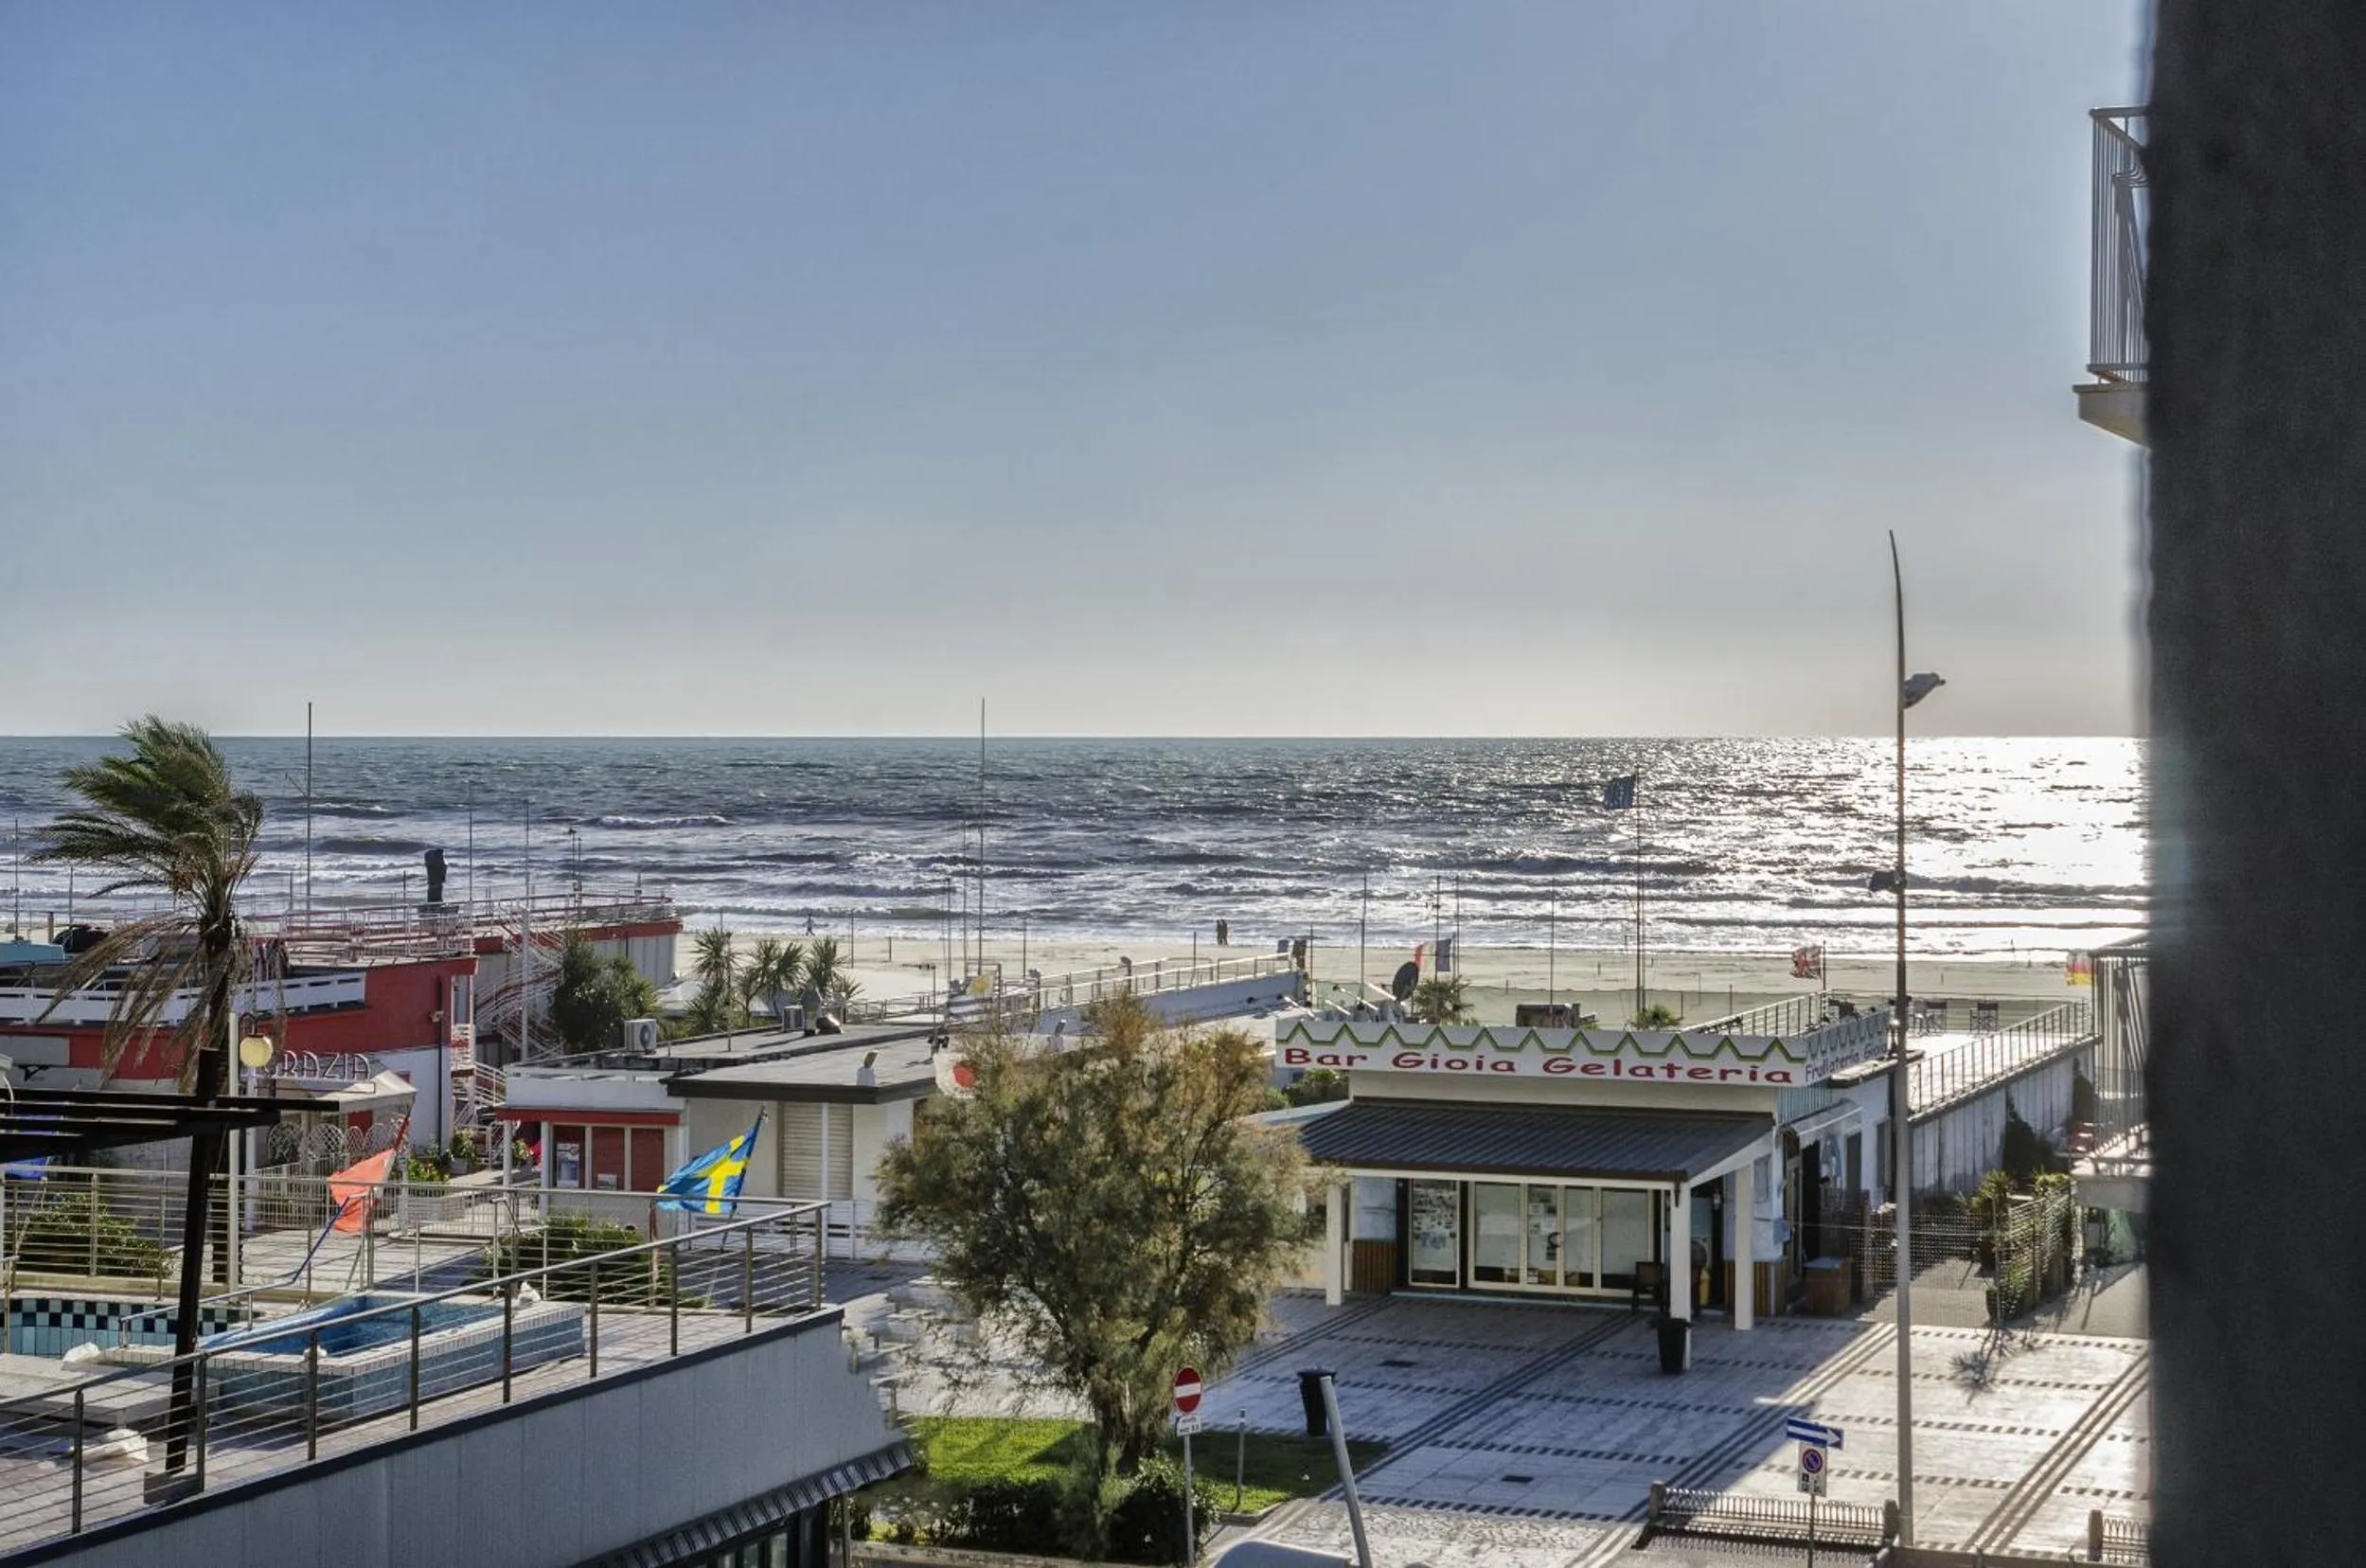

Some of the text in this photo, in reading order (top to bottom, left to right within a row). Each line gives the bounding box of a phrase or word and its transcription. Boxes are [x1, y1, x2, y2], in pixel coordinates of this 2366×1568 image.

[1285, 1048, 1791, 1083] Bar Gioia Gelateria
[1806, 1049, 1859, 1082] Frullateria
